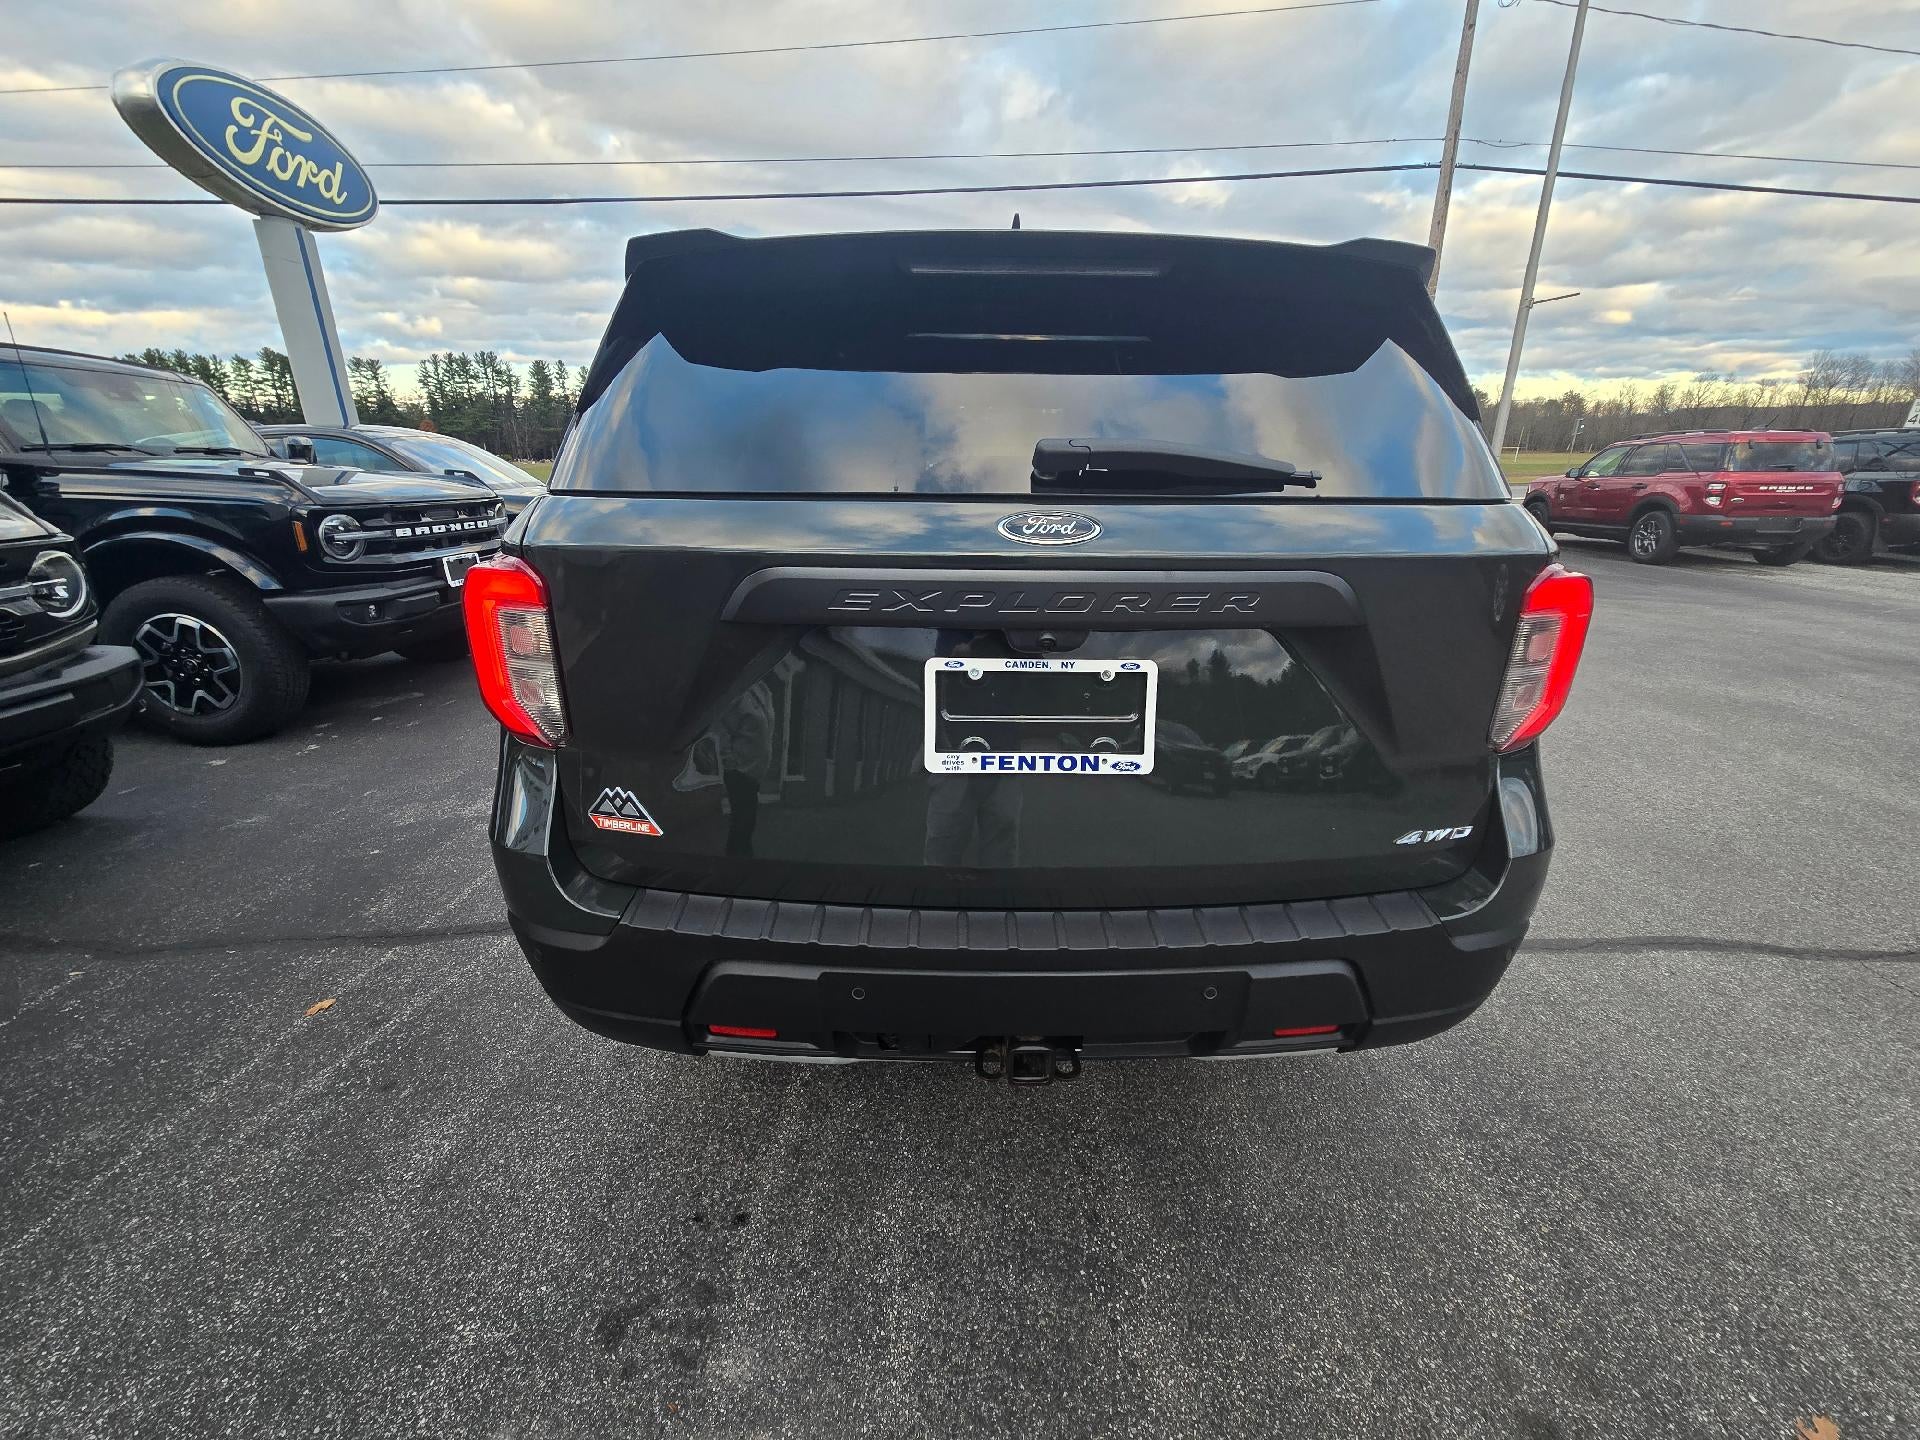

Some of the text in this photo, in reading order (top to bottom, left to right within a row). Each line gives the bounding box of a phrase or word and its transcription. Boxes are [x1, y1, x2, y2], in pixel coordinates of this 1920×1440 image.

[225, 96, 348, 205] Ford
[395, 520, 489, 538] BRONCO
[1022, 515, 1077, 534] Ford
[826, 588, 1261, 614] EXPLORER
[1004, 660, 1076, 669] CAMDEN, NY
[980, 755, 1100, 772] FENTON
[597, 817, 651, 833] TIMBERLINE
[1392, 825, 1474, 845] 4WD
